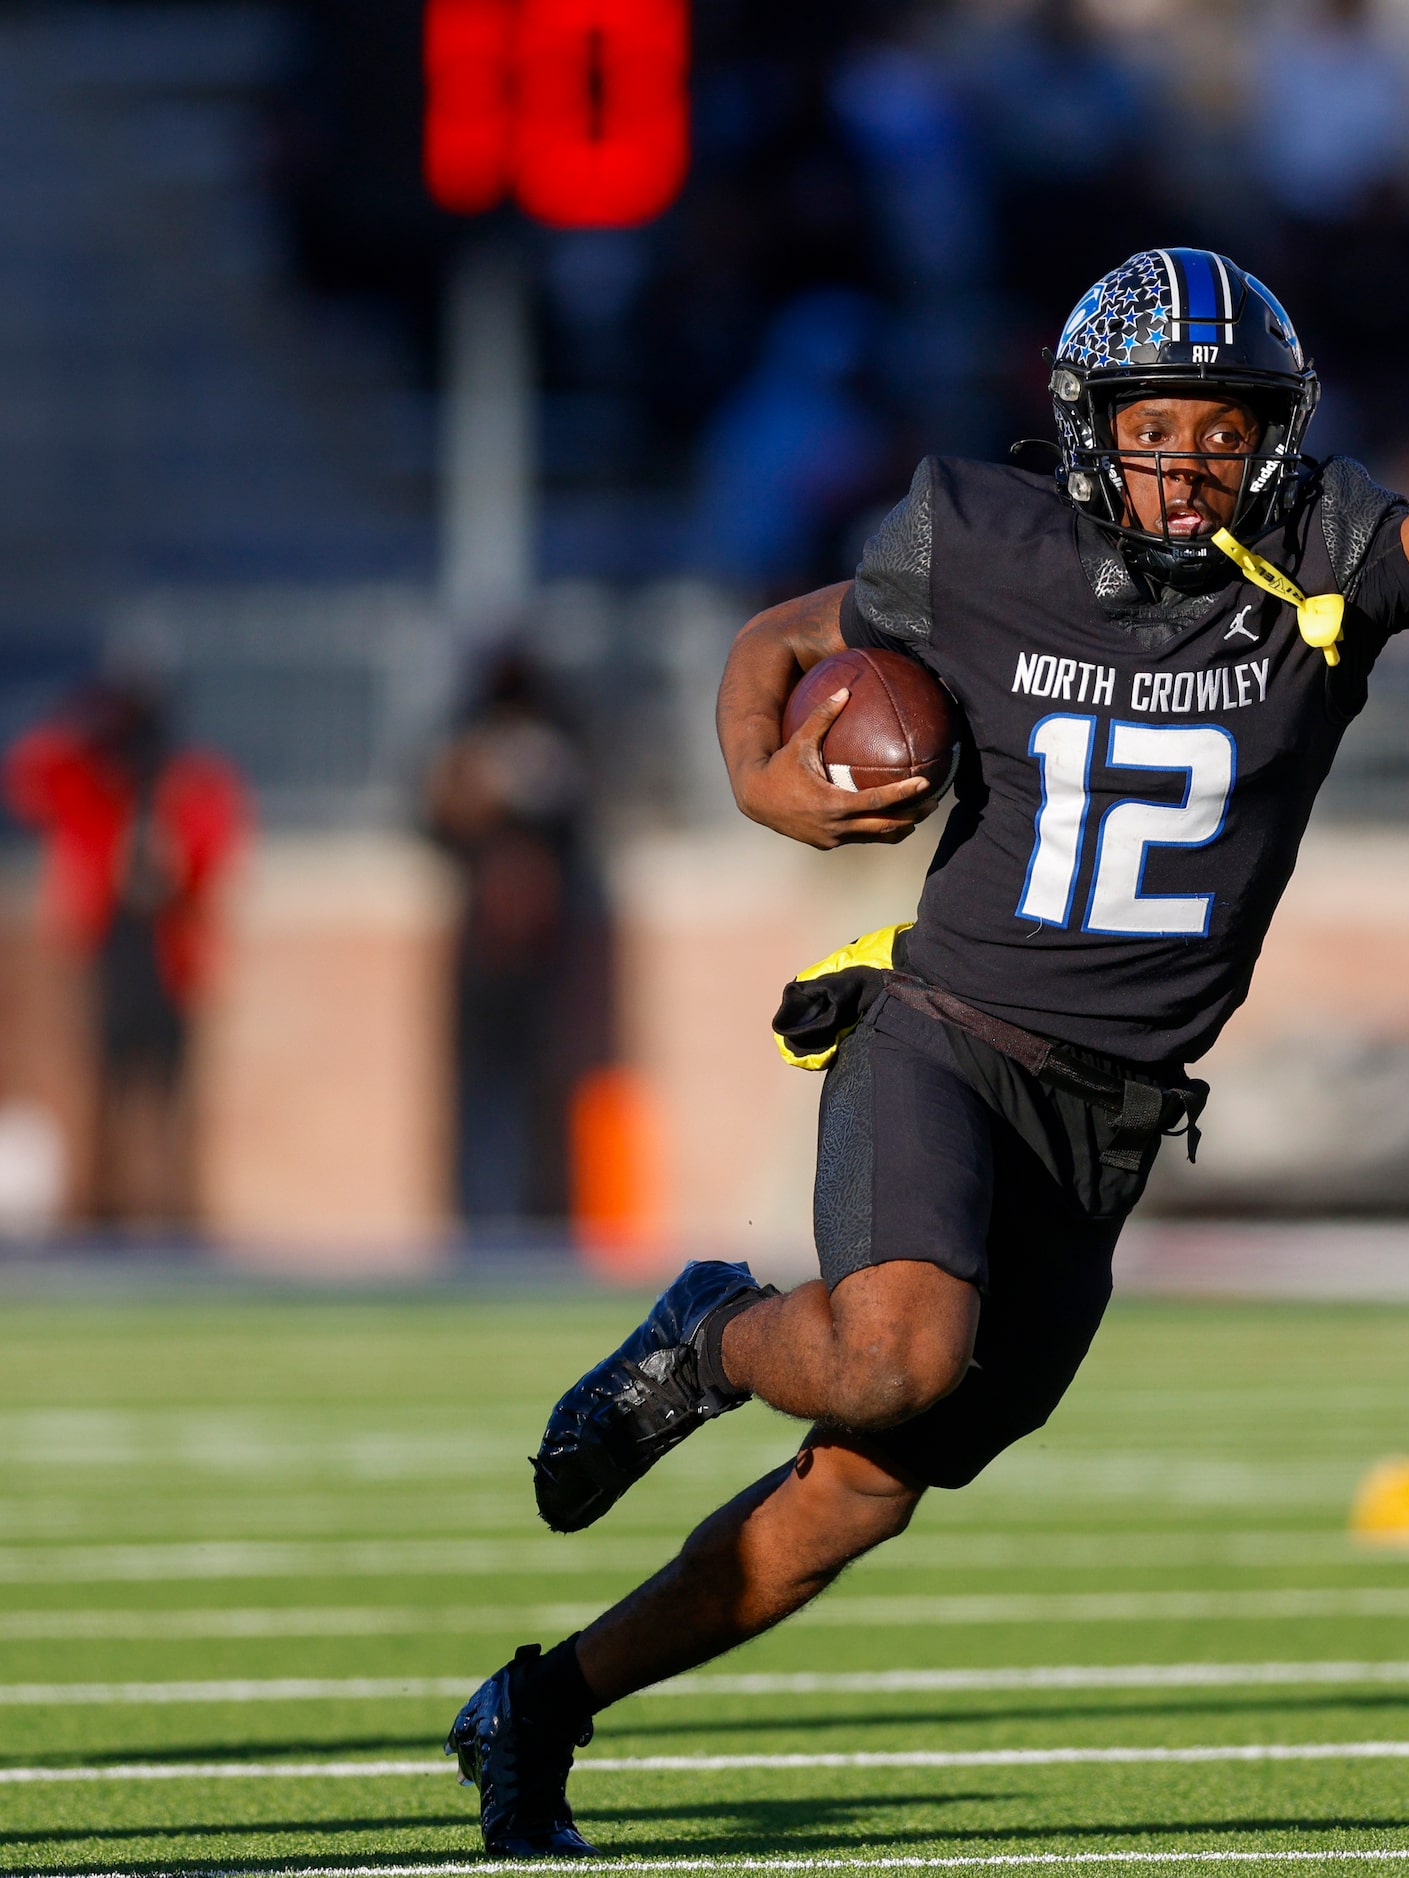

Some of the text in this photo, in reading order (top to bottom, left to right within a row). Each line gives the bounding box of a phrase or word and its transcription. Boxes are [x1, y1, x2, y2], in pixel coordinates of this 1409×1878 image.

[1193, 346, 1219, 364] 817
[1012, 652, 1270, 713] NORTH CROWLEY
[1014, 711, 1238, 938] 12
